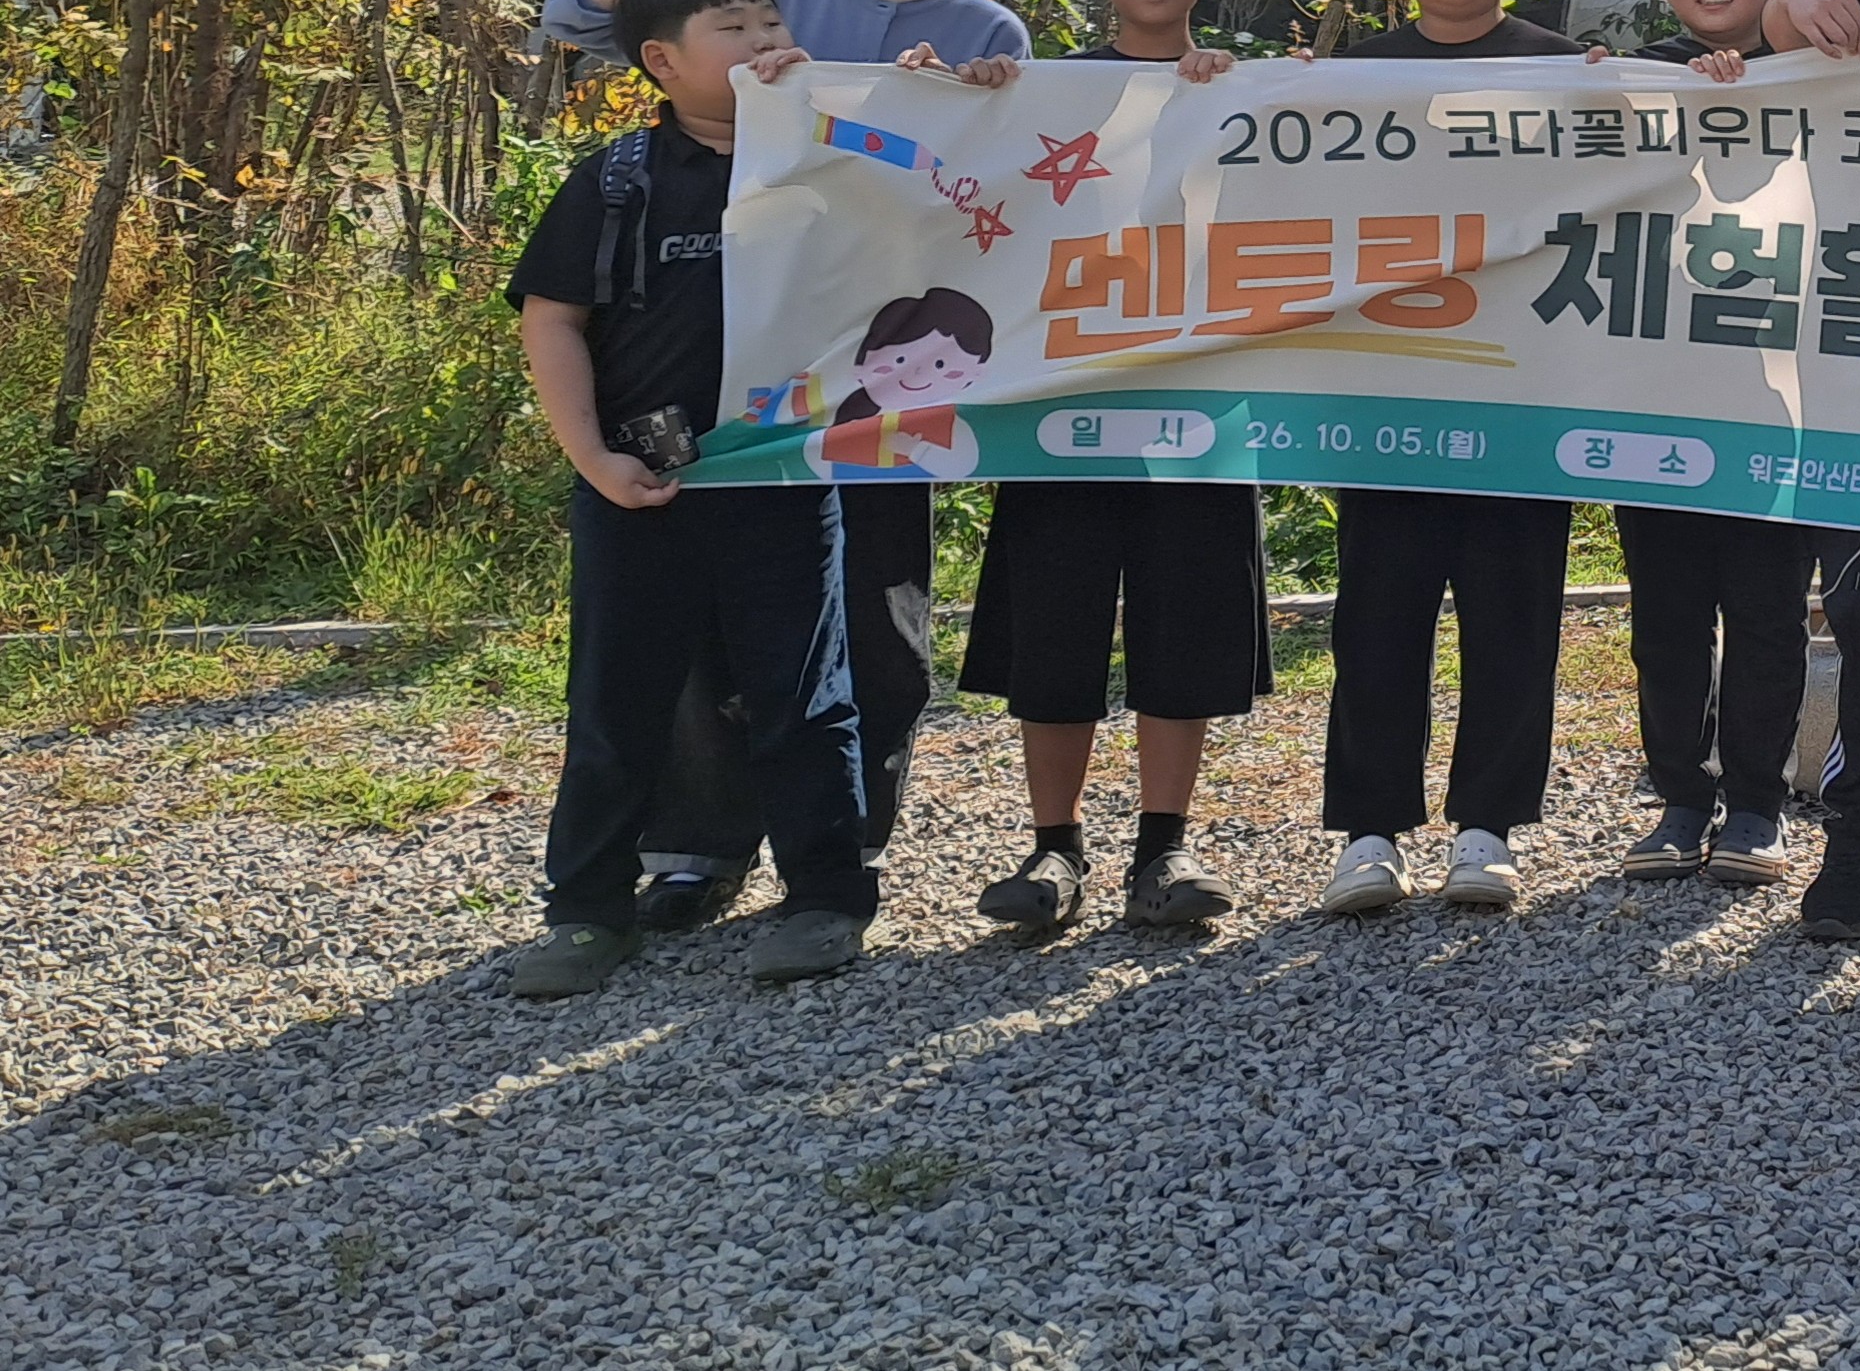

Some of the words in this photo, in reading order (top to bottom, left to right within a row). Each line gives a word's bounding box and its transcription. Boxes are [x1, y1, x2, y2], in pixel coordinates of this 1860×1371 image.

[1217, 109, 1418, 166] 2026
[1445, 106, 1816, 162] 코다꽃피우다
[1039, 213, 1486, 360] 멘토링
[1245, 421, 1303, 450] 26.
[1316, 423, 1362, 452] 10.
